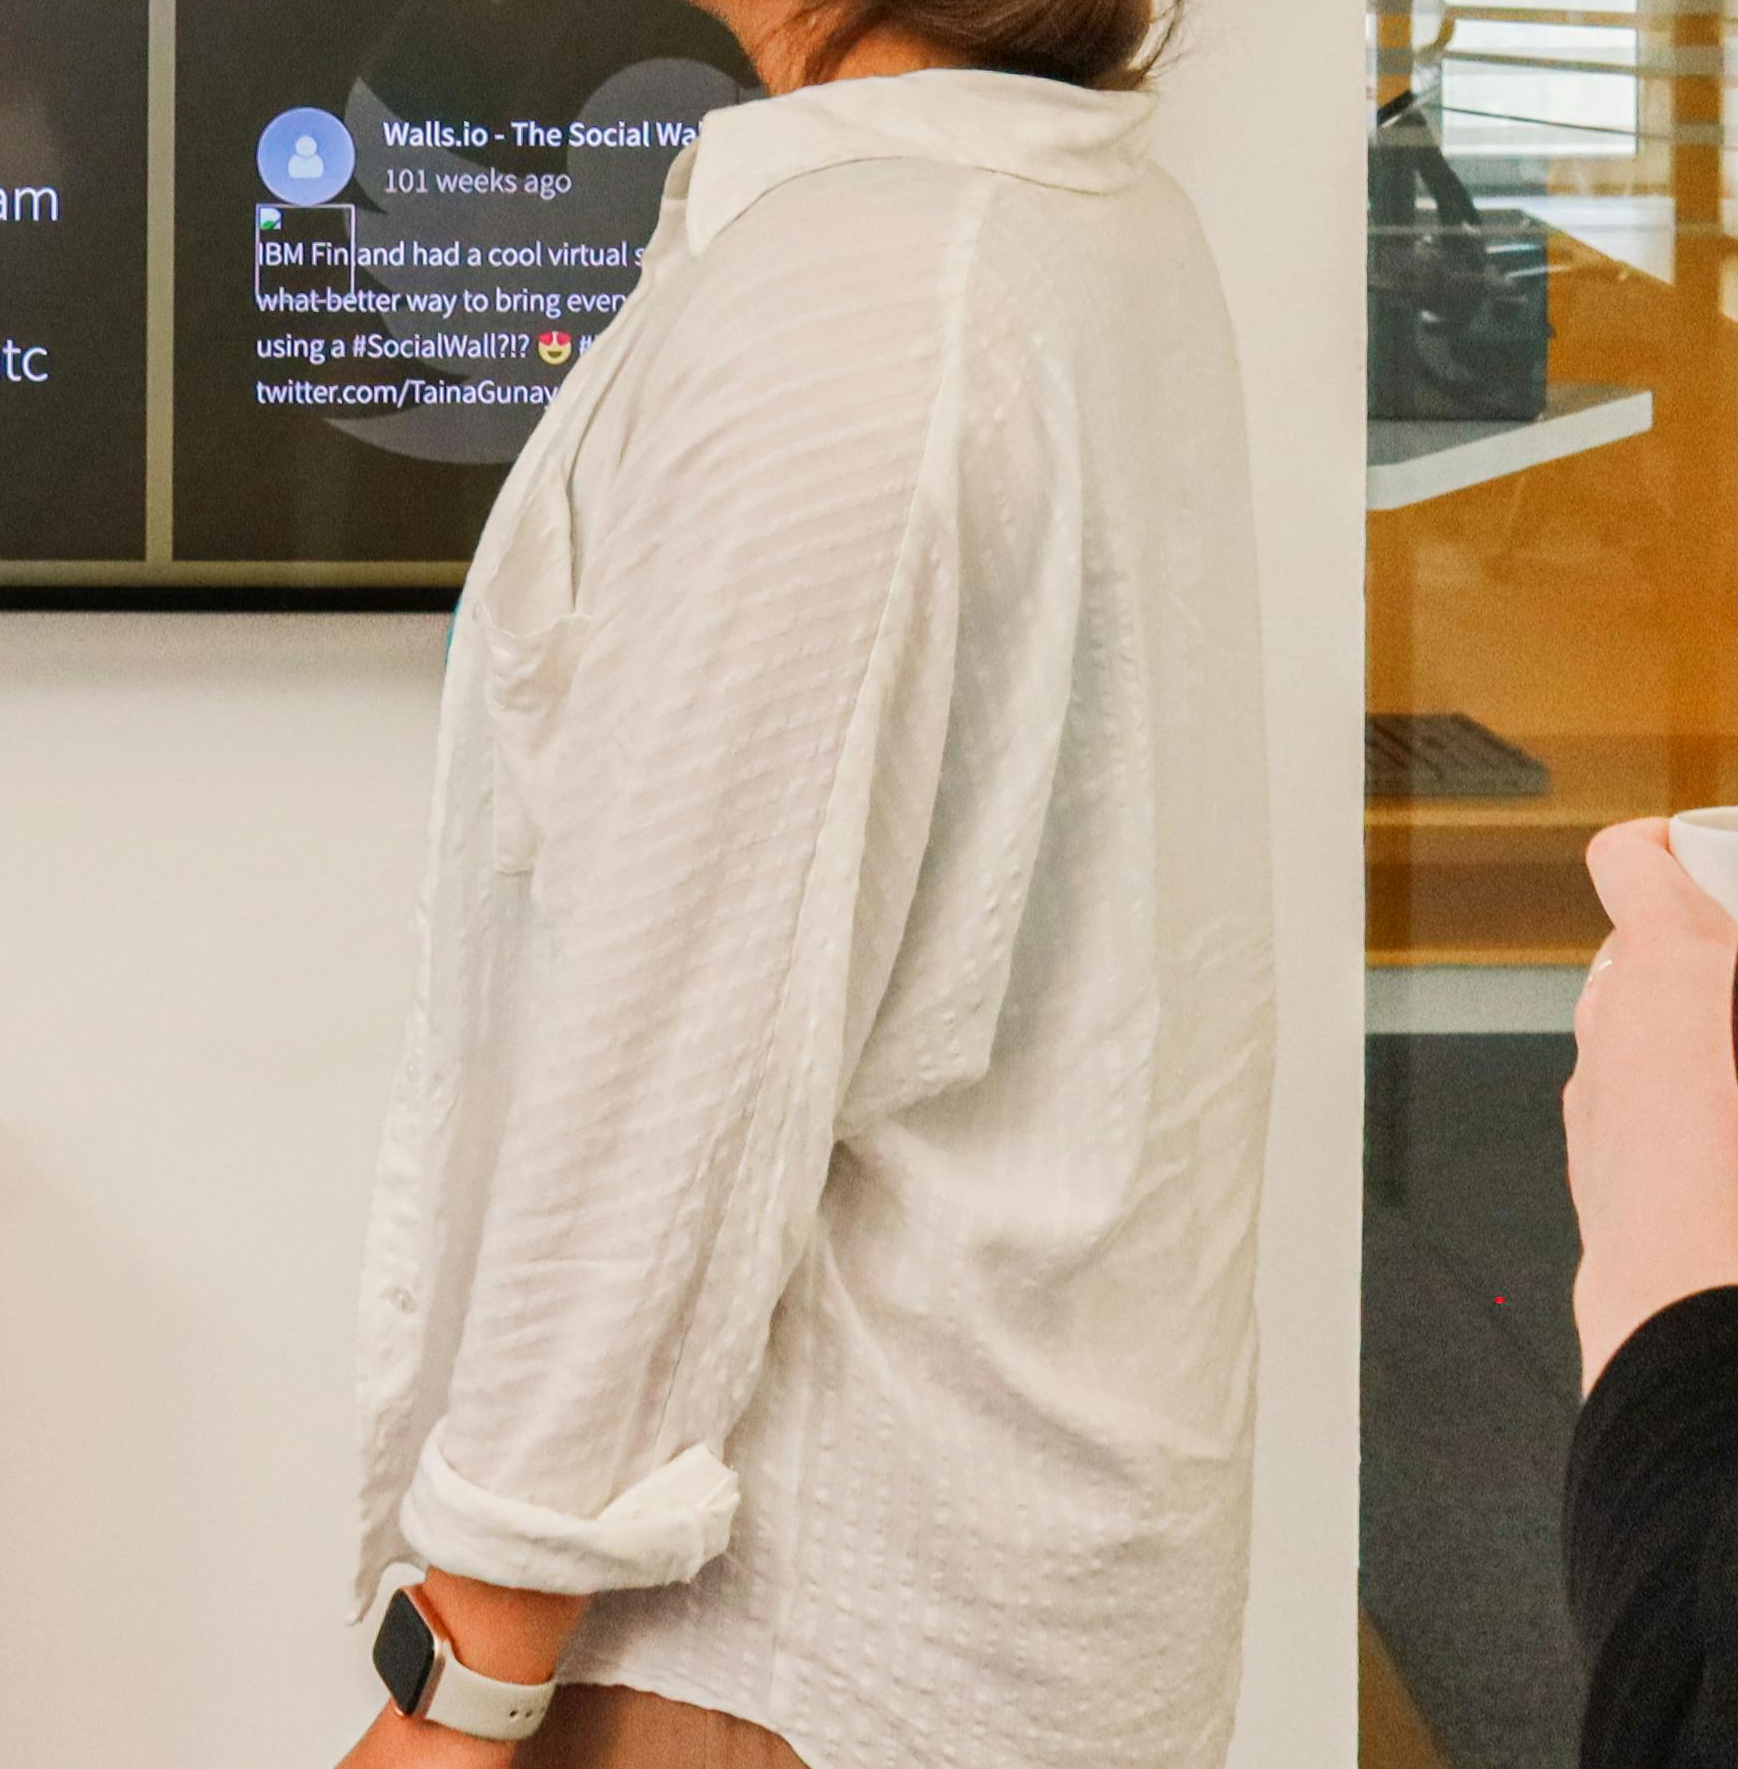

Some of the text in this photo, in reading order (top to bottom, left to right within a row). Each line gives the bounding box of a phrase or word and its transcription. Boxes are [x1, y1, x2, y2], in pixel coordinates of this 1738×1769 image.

[383, 120, 490, 148] Walls.io
[510, 120, 563, 148] The
[567, 121, 651, 149] Social
[384, 167, 574, 202] 101 weeks ago
[257, 241, 305, 267] IBM
[412, 240, 462, 267] had
[467, 247, 484, 268] a
[488, 241, 544, 268] cool
[547, 240, 629, 268] virtual
[256, 287, 319, 313] what
[326, 287, 404, 314] better
[405, 293, 458, 320] way
[463, 290, 491, 314] to
[495, 287, 563, 321] bring
[256, 333, 328, 366] using
[330, 339, 348, 360] a
[352, 333, 532, 360] #SocialWall?!?
